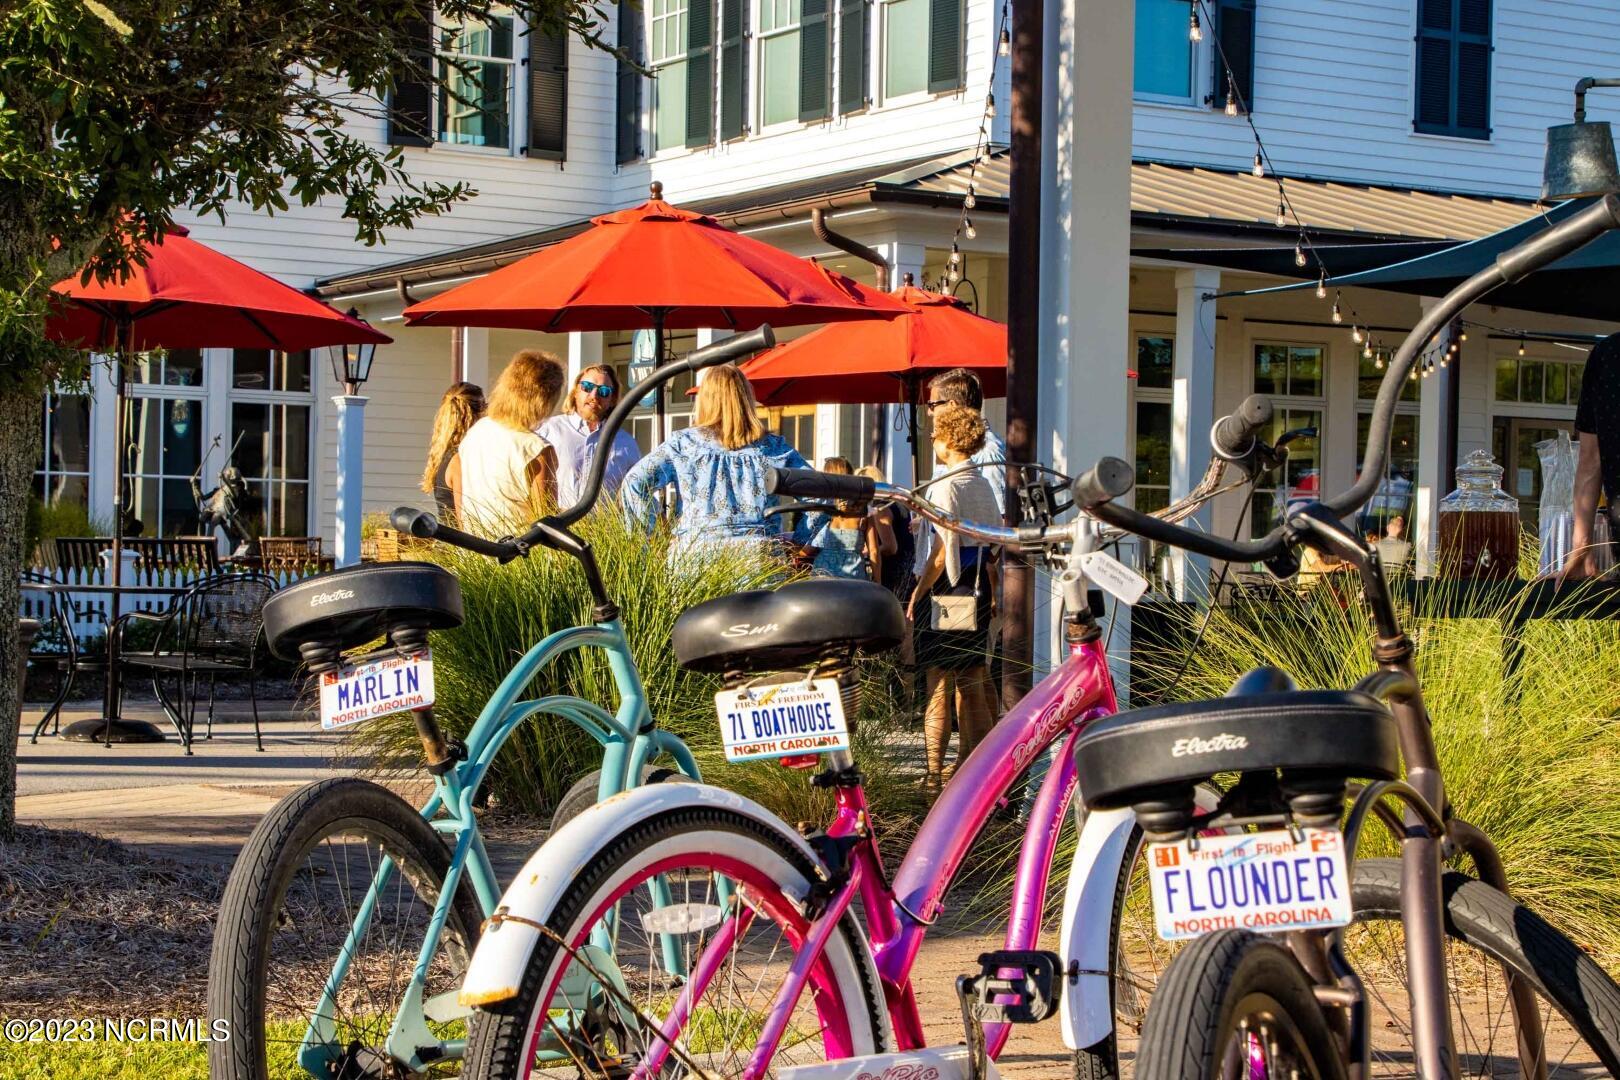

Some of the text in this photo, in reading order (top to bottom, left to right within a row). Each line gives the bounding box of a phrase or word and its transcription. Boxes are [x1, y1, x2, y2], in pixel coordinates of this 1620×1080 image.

[310, 589, 355, 607] Electra
[720, 623, 779, 638] Sun
[338, 665, 419, 711] MARLIN
[778, 692, 825, 704] FREEDOM
[331, 694, 424, 725] NORTH CAROLINA
[728, 702, 836, 740] 71 BOATHOUSE
[733, 735, 840, 756] NORTH CAROLINA
[1171, 732, 1249, 758] Electra
[1191, 847, 1224, 861] First
[1256, 840, 1298, 855] Flight
[1164, 856, 1337, 914] FLOUNDER
[1174, 907, 1333, 934] NORTH CAROLINA
